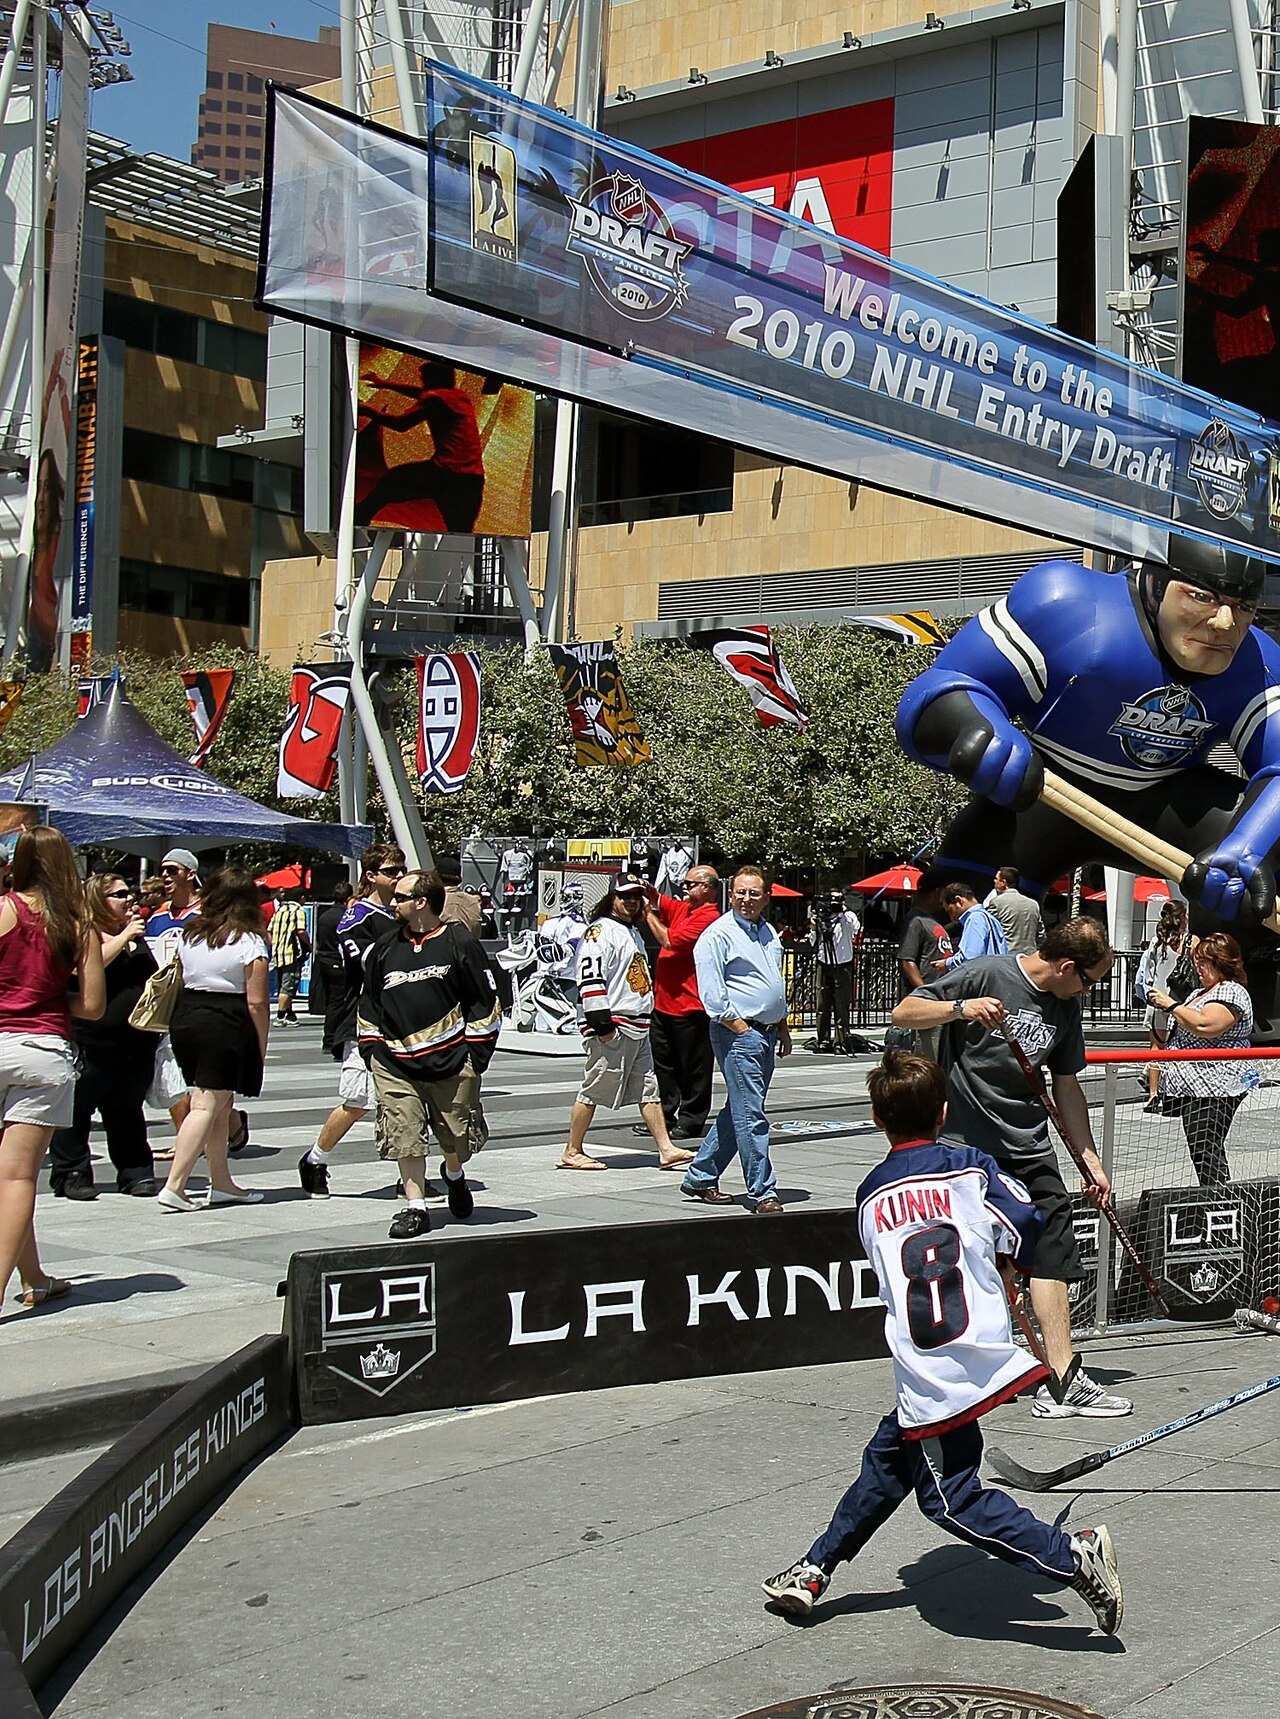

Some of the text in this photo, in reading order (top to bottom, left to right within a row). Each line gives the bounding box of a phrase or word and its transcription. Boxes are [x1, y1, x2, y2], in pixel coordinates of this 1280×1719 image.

[619, 190, 642, 209] NHL
[573, 207, 687, 269] DRAFT
[595, 249, 664, 281] LOS ANGELES
[620, 287, 645, 304] 2010
[823, 263, 1114, 418] Welcome to the
[726, 295, 1172, 492] 2010 NHL Entry Draft
[77, 344, 99, 503] DRINKABLITY
[1191, 442, 1248, 480] DRAFT
[78, 508, 89, 606] THE DIFFERENCE IS
[1119, 705, 1214, 738] DRAFT
[1166, 694, 1186, 708] NHL
[1130, 731, 1185, 746] LOS ANGELES
[91, 777, 229, 794] BUD LIGHT
[580, 955, 604, 979] 21
[873, 1188, 953, 1234] KUNIN
[1169, 1209, 1240, 1246] LA
[328, 1274, 430, 1323] LA
[901, 1223, 970, 1351] 8
[507, 1278, 647, 1346] LA
[21, 1376, 265, 1664] LOS ANGELES KINGS
